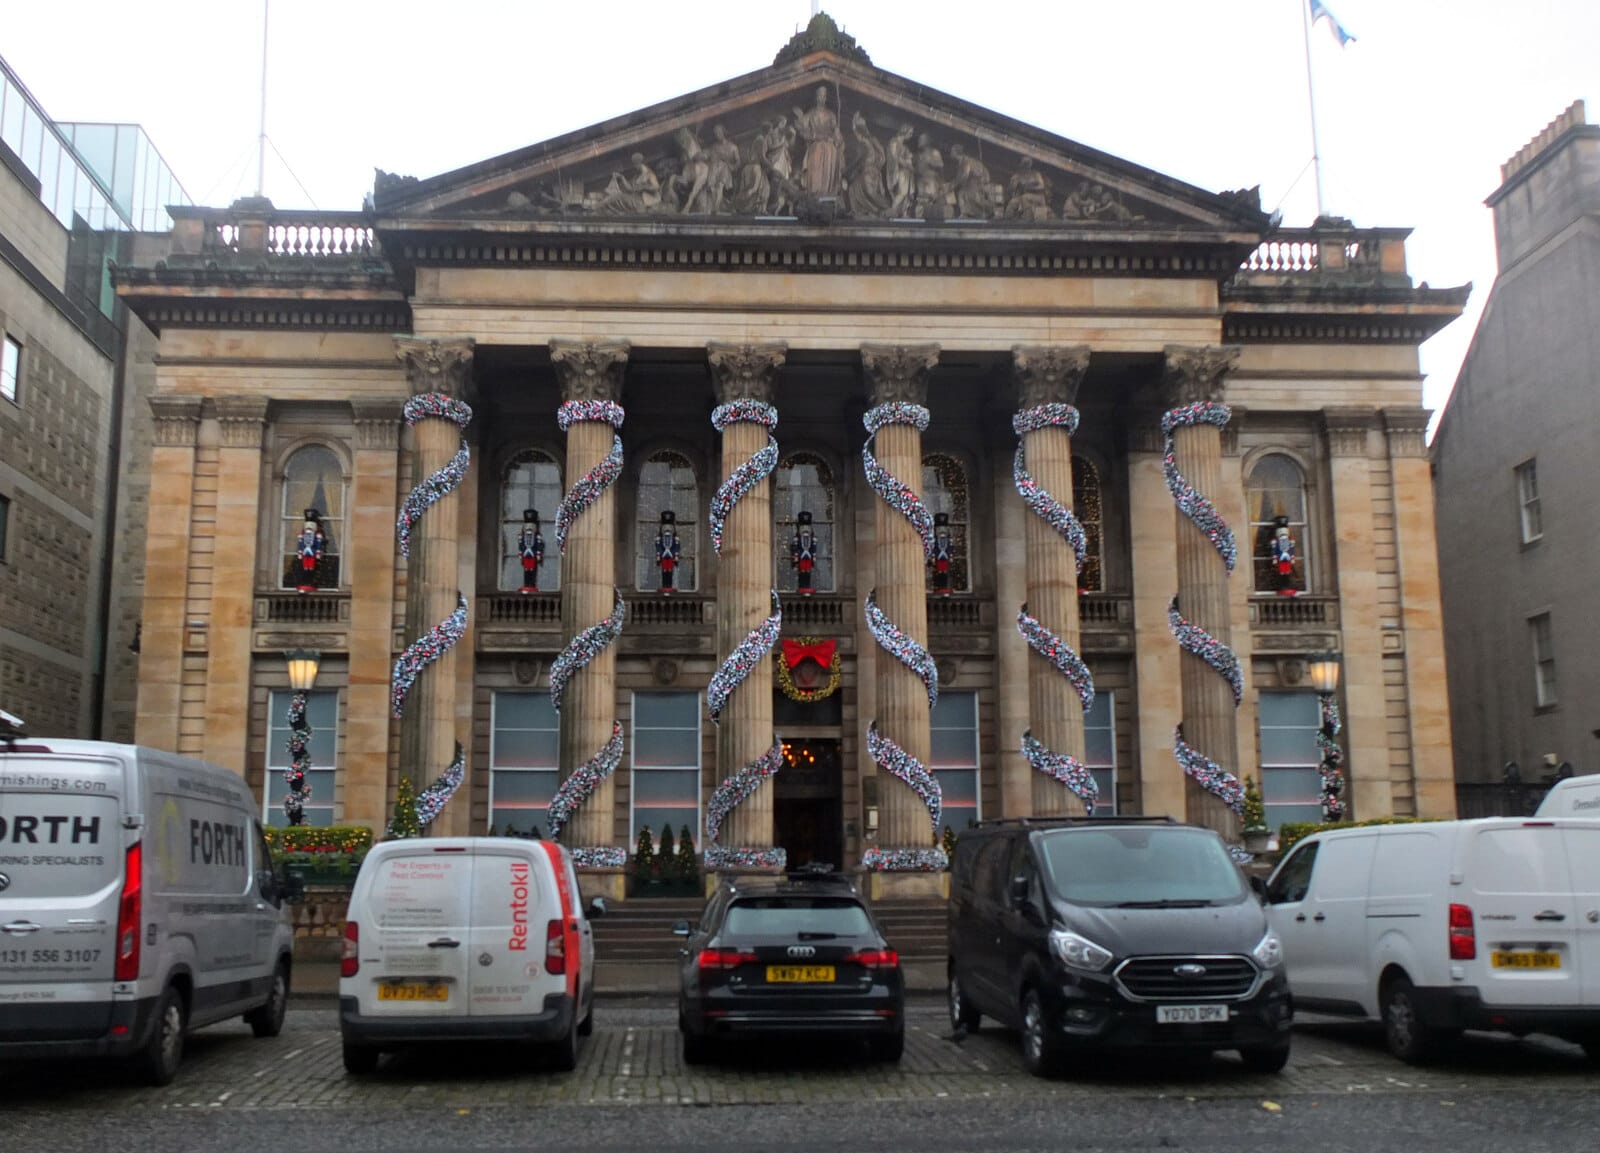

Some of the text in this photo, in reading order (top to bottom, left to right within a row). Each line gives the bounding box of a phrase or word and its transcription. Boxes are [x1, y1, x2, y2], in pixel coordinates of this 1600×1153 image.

[0, 815, 101, 844] RTH
[190, 818, 245, 867] FORTH
[32, 855, 104, 866] SPECIALISTS
[508, 862, 529, 951] Rentokil
[63, 949, 102, 962] 3107
